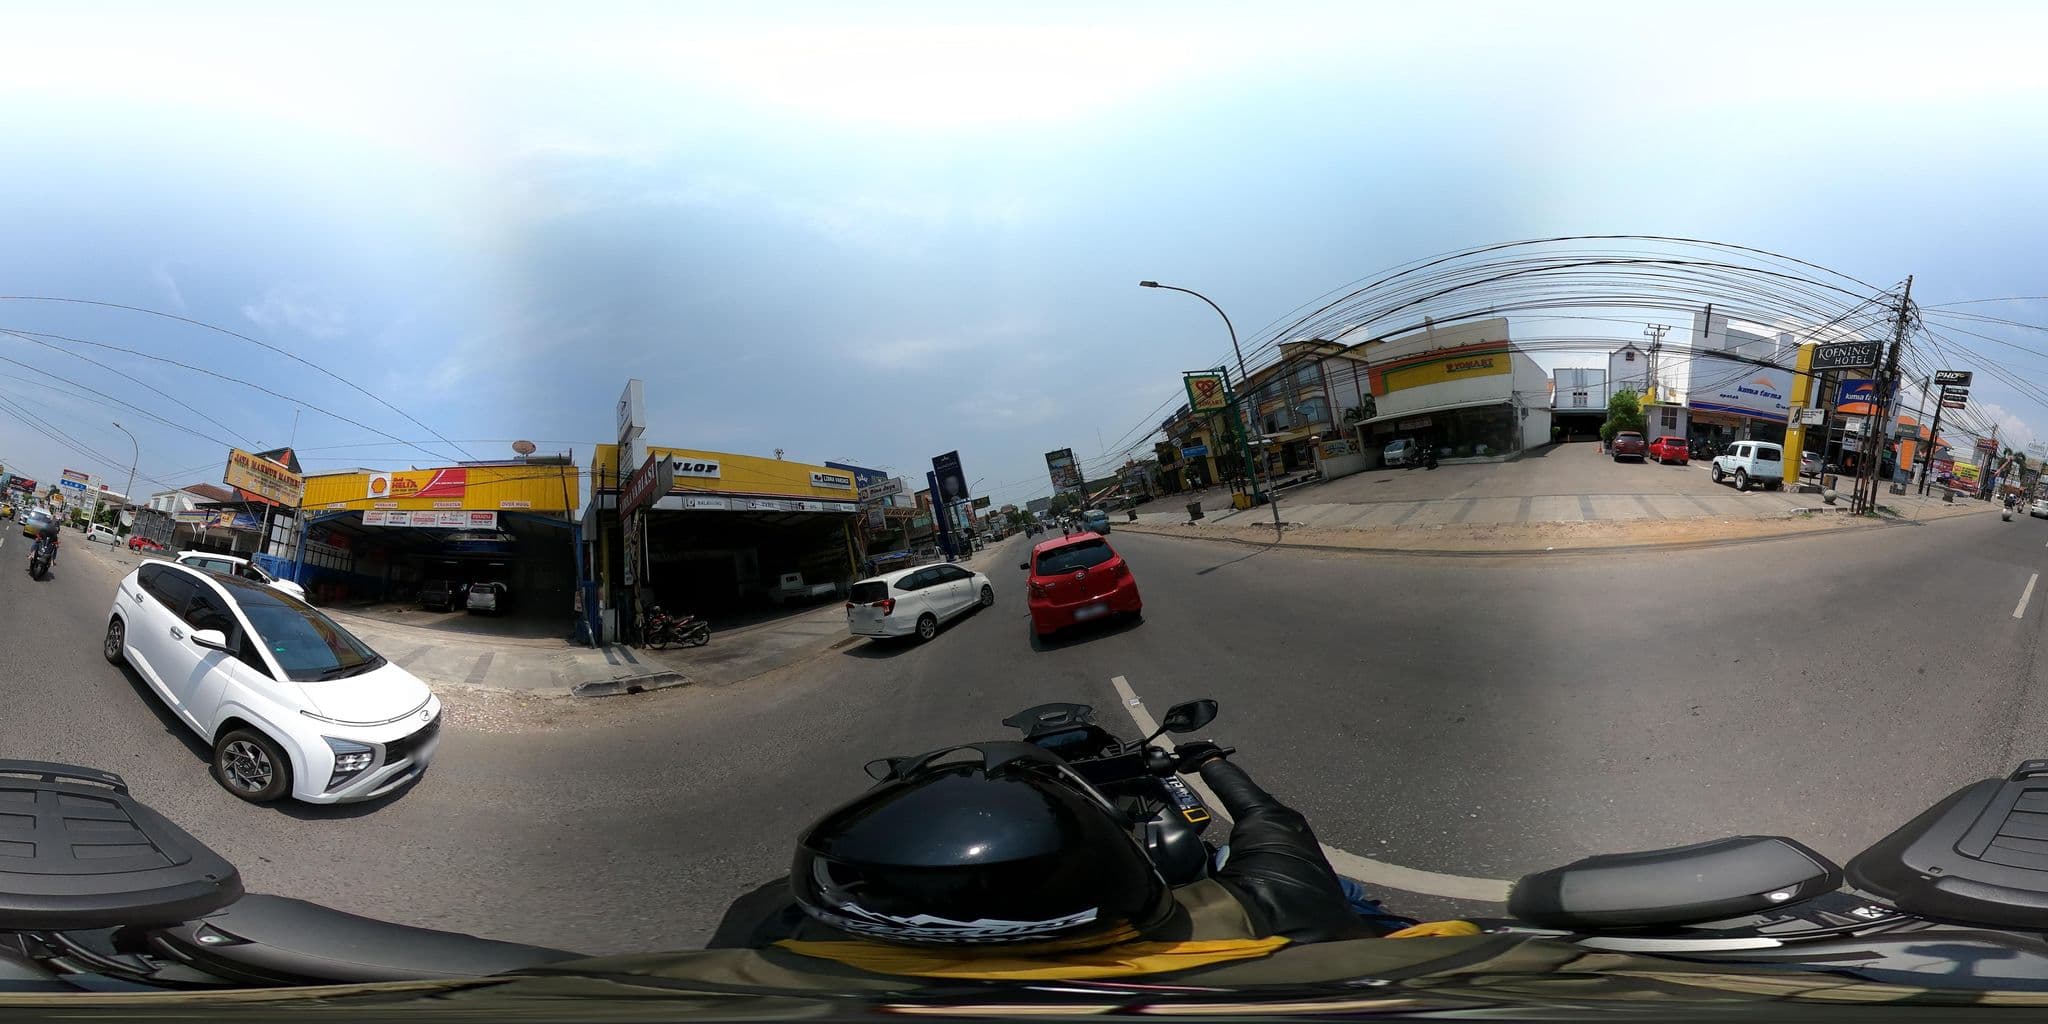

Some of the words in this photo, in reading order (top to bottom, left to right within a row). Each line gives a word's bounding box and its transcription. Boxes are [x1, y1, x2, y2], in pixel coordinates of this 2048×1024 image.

[1454, 358, 1493, 368] YOMART
[1834, 355, 1869, 365] HOTEL
[1936, 371, 1958, 379] PHD
[392, 480, 418, 489] HELIX
